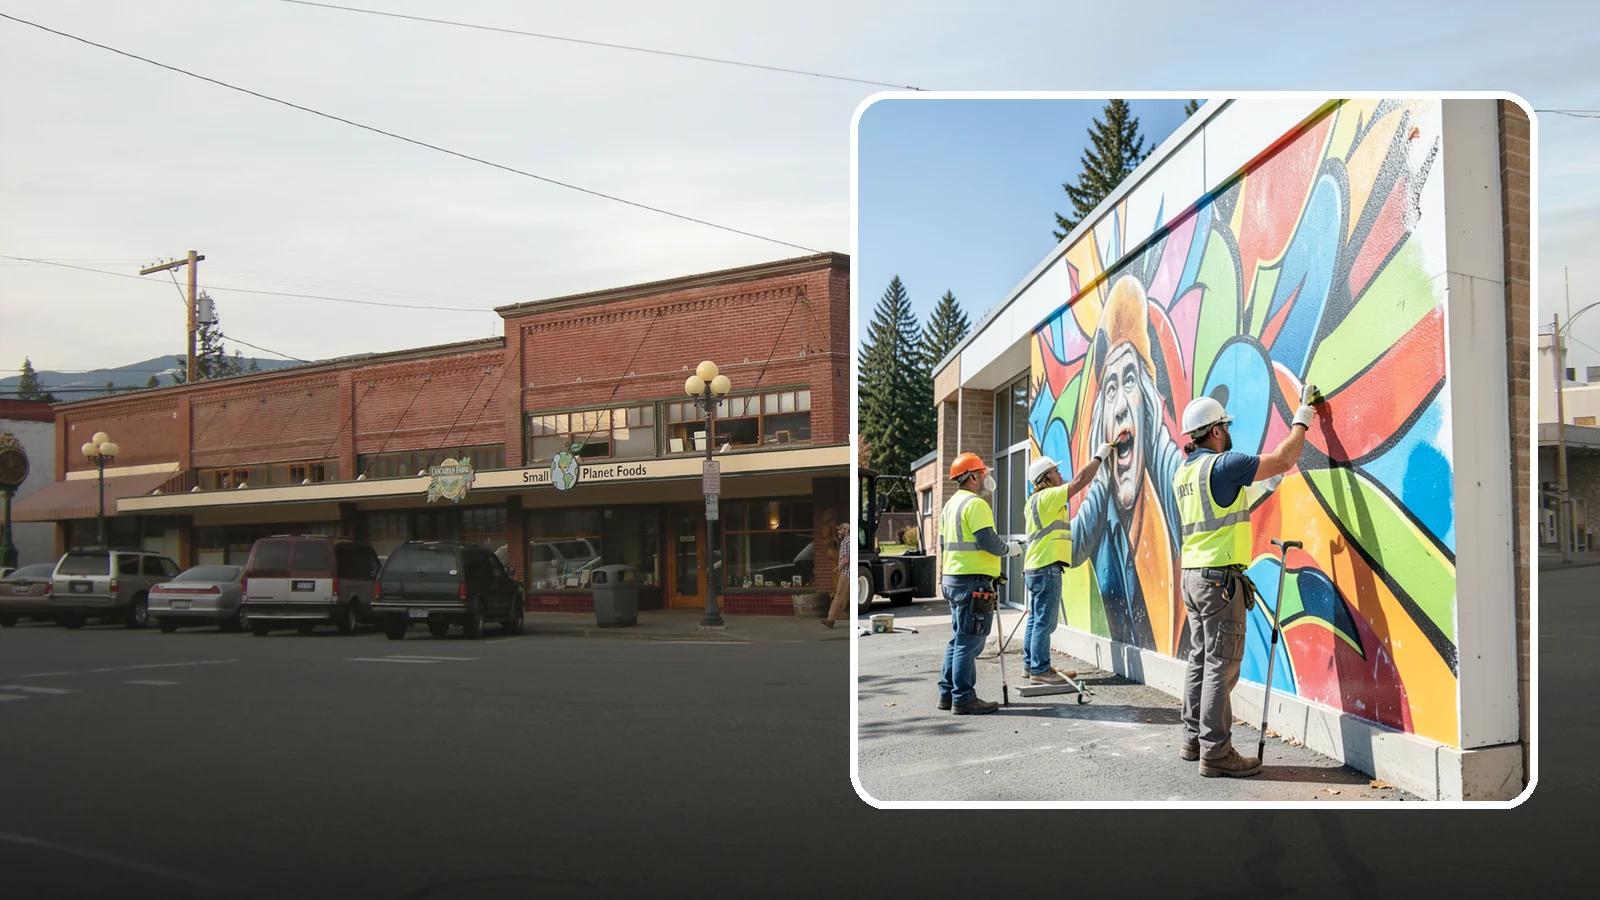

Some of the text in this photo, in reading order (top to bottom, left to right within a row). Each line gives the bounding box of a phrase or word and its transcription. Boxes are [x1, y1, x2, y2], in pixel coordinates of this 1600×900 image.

[523, 464, 647, 483] Small Planet Foods
